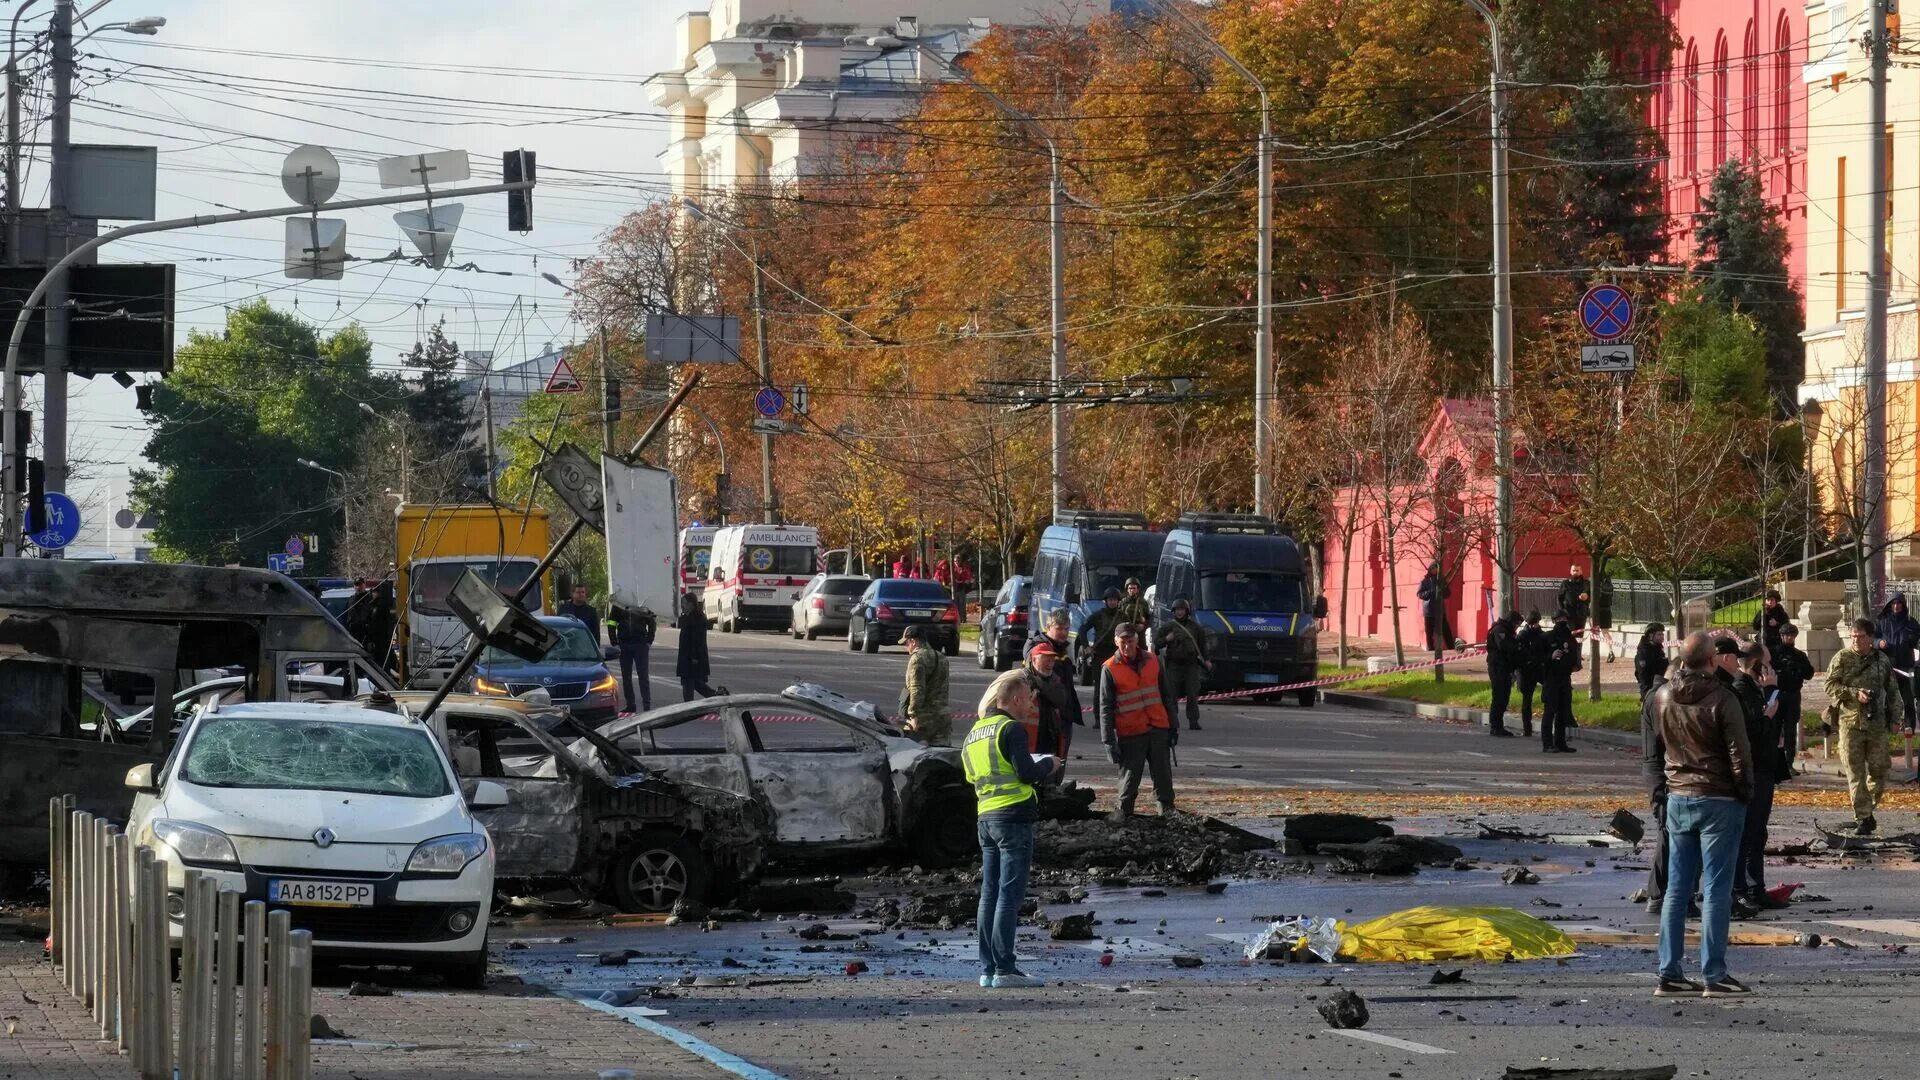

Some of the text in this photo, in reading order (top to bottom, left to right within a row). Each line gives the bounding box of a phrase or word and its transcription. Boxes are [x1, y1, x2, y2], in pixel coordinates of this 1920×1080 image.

[564, 464, 579, 484] 10
[749, 533, 813, 543] AMBULANCE
[968, 724, 996, 743] ОЛІЦІЯ
[280, 884, 369, 902] AA 8152 PP
